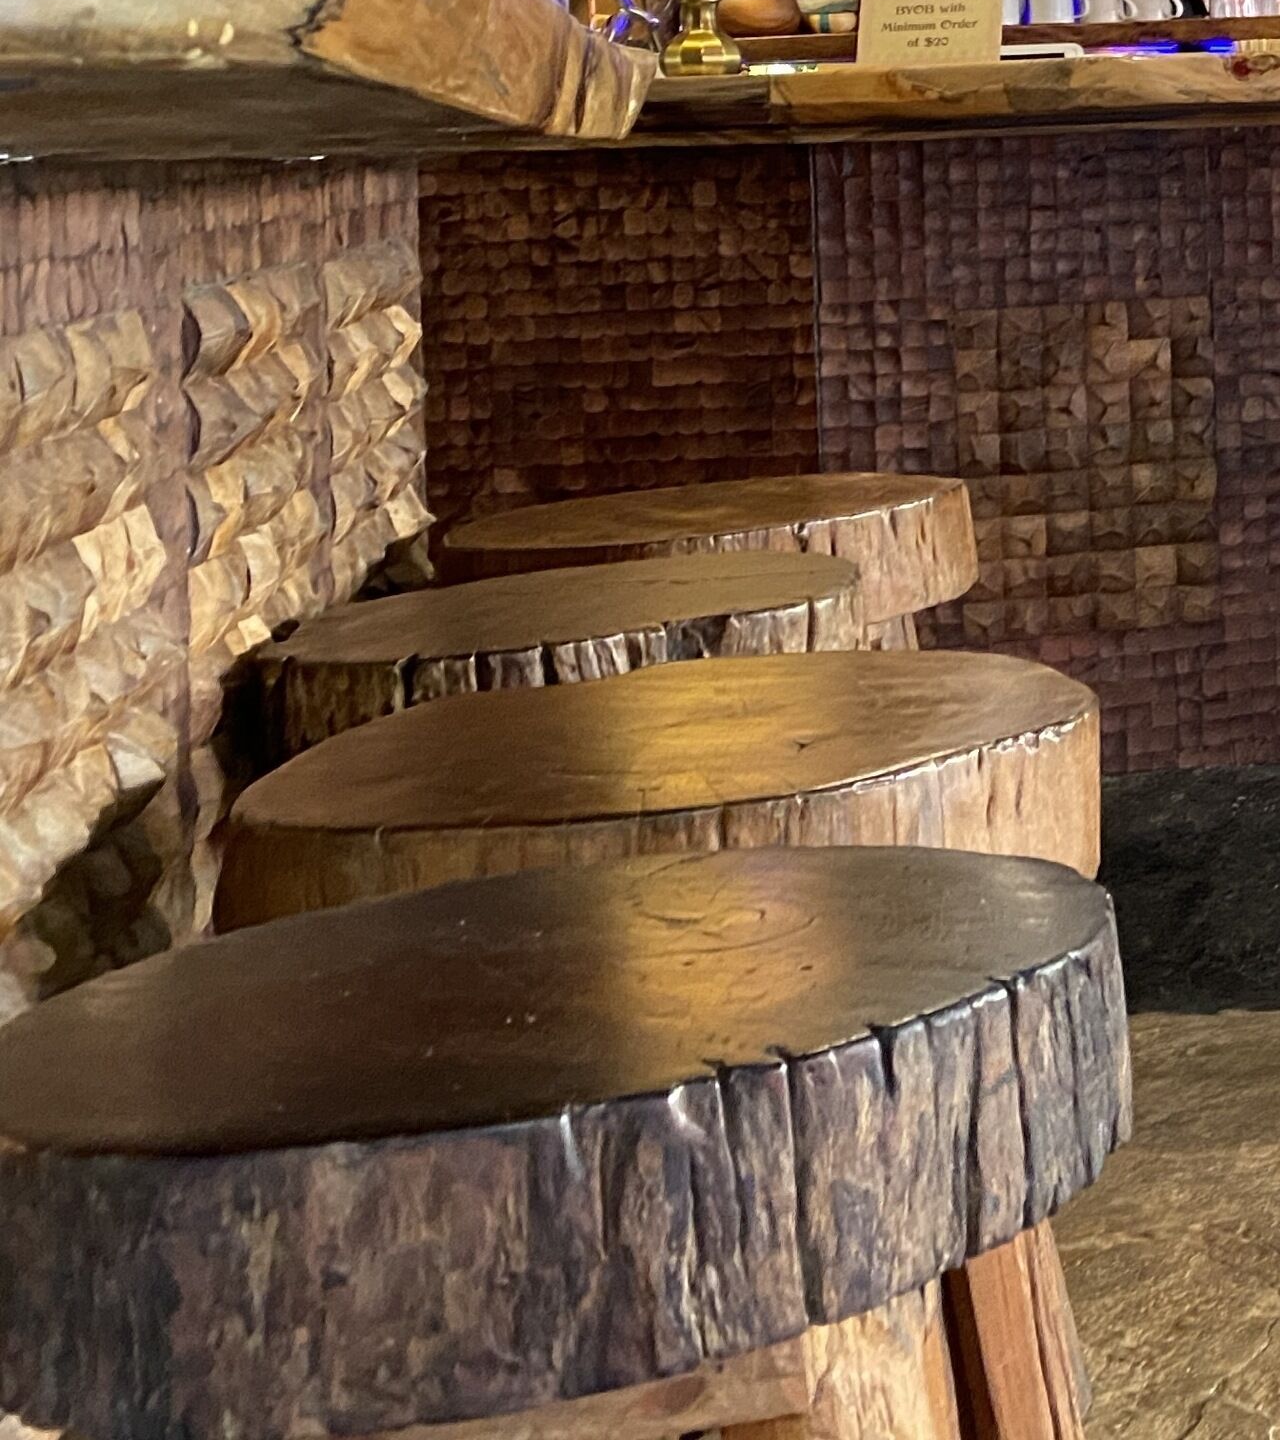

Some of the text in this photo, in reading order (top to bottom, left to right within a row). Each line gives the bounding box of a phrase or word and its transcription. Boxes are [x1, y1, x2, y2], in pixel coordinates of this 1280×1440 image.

[895, 2, 966, 15] BYOB with
[881, 18, 978, 32] Minimum Order
[907, 37, 949, 48] of $20
